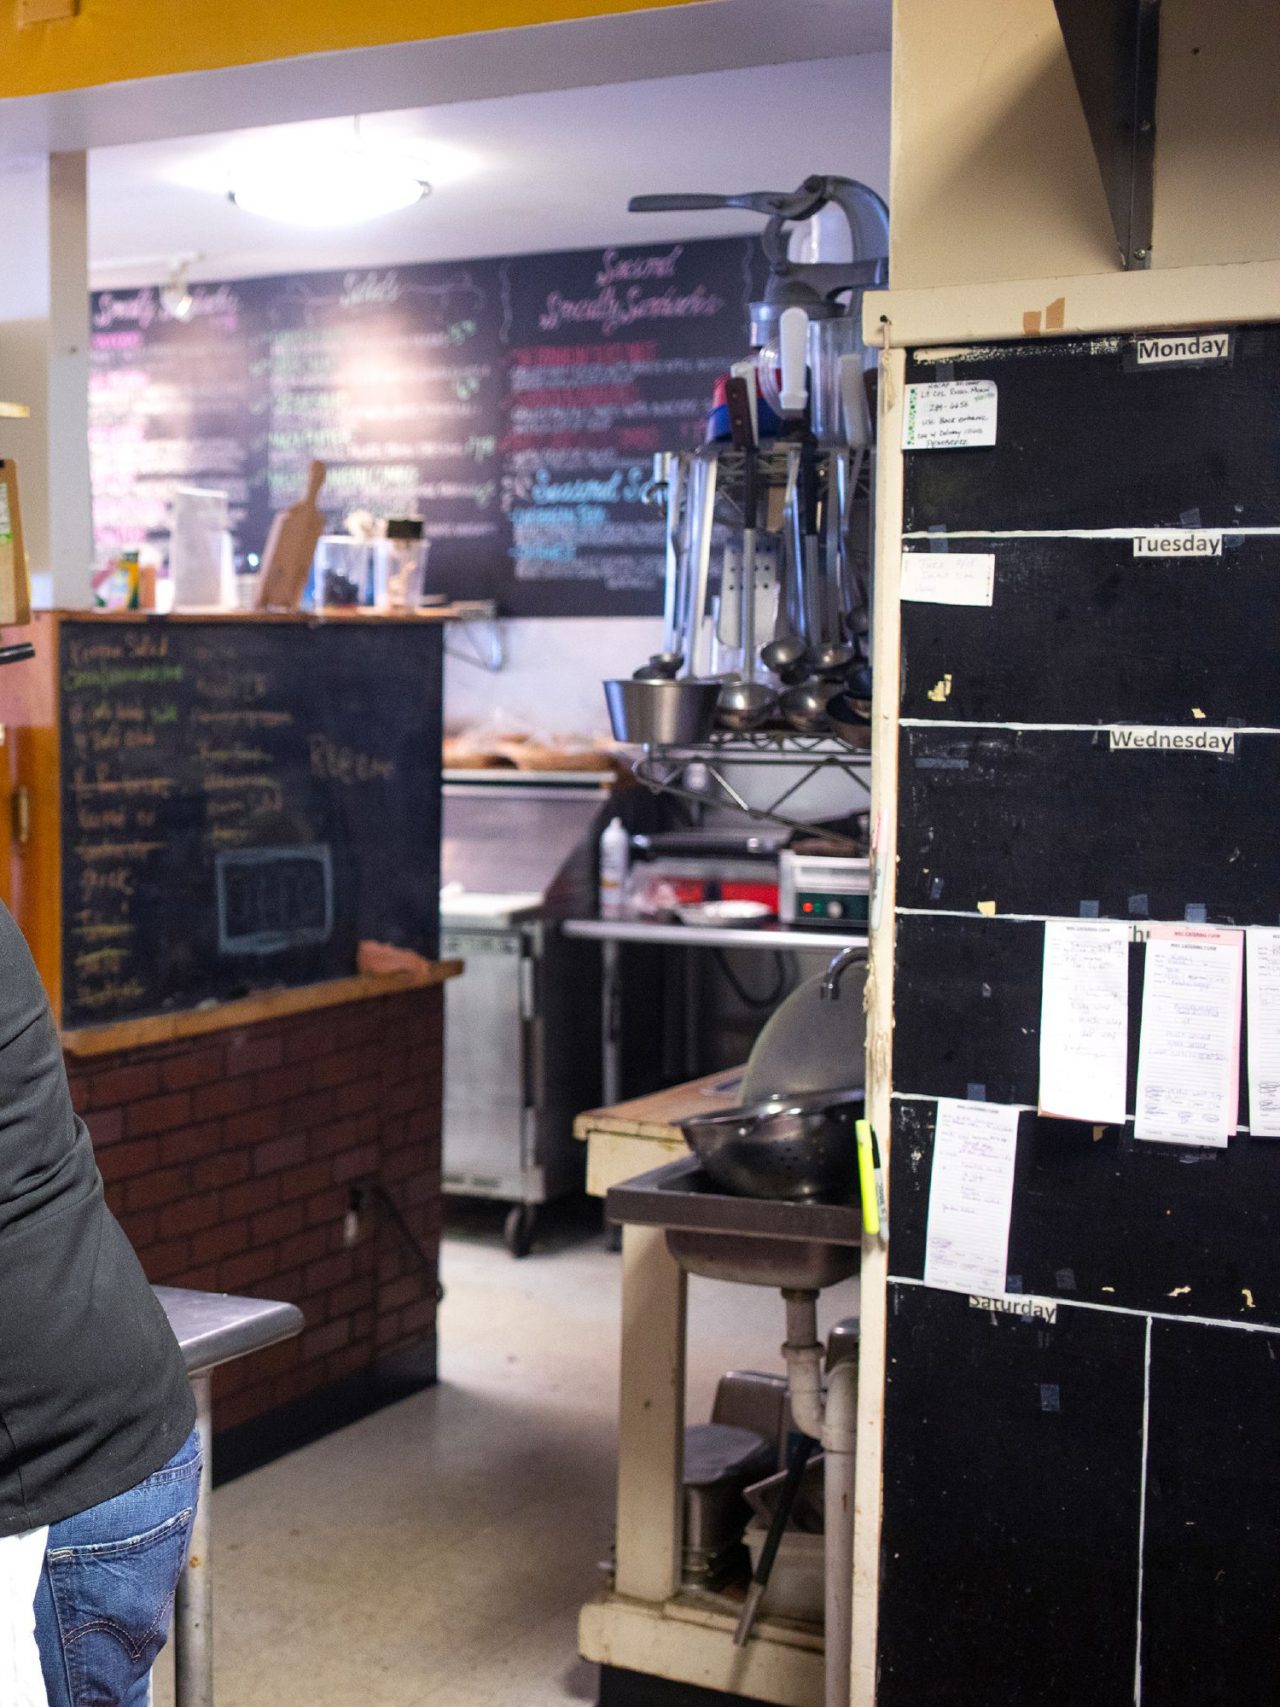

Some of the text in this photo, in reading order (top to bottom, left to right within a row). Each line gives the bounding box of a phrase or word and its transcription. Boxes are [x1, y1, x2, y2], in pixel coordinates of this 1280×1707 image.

[1138, 338, 1225, 359] Monday
[1134, 534, 1221, 555] Tuesday
[1111, 730, 1233, 753] Wednesday
